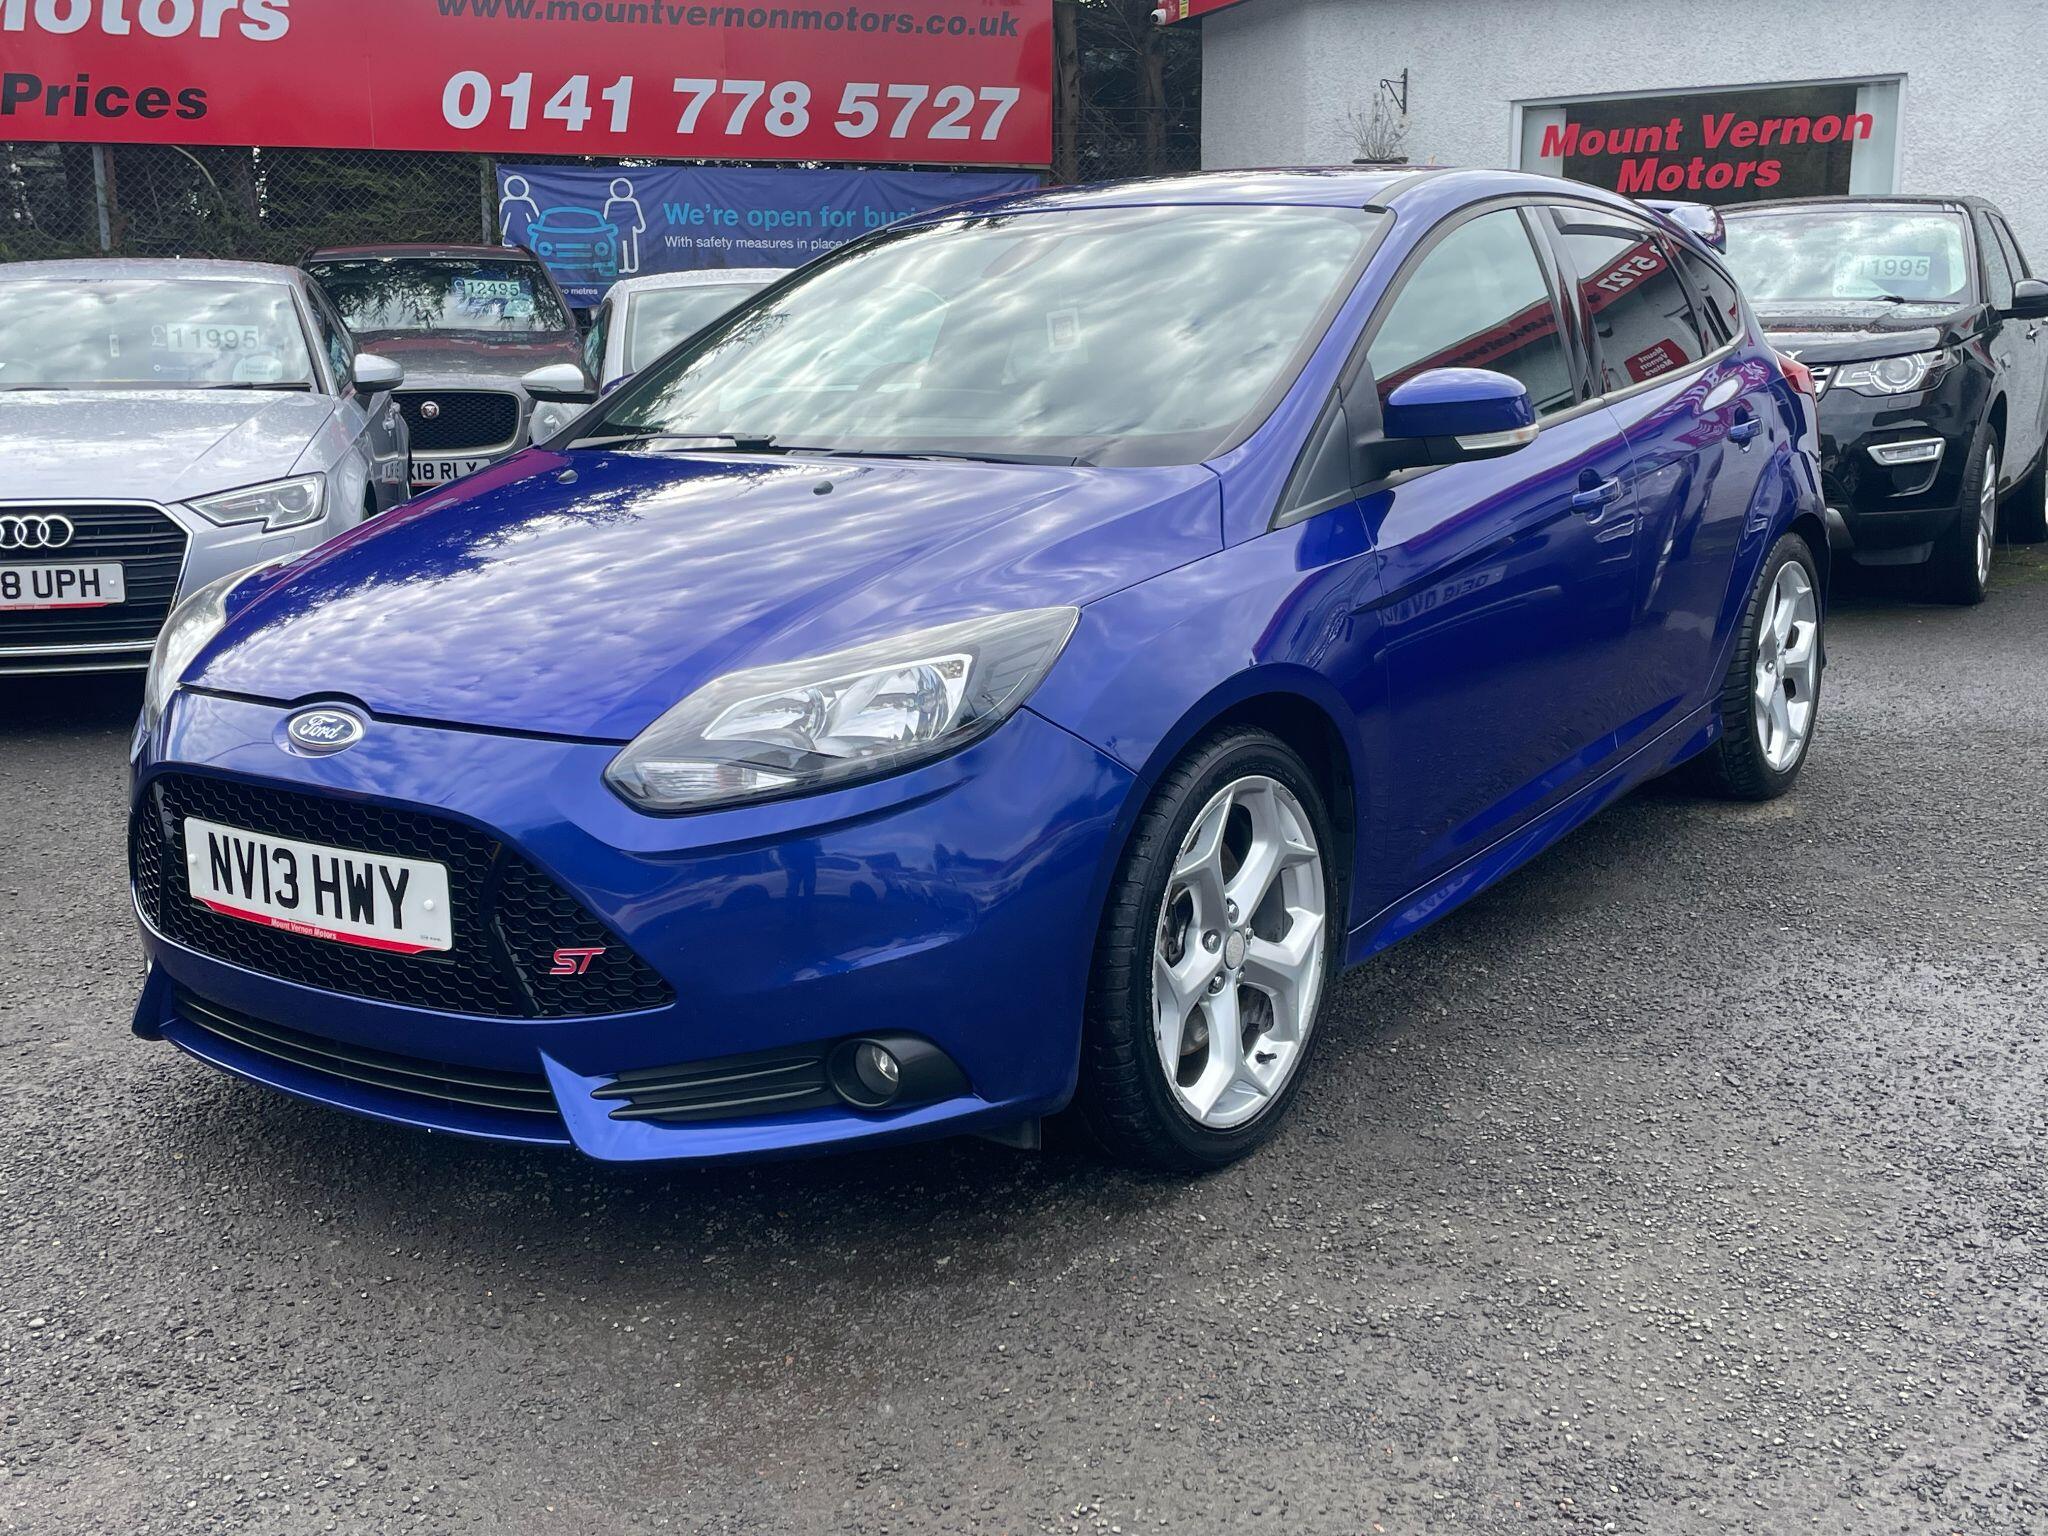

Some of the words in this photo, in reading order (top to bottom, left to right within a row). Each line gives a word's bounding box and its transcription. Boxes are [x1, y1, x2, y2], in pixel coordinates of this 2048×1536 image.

[0, 0, 290, 41] otors
[438, 0, 1019, 37] www.mountvernonmotors.co.uk
[0, 72, 208, 120] Prices
[442, 70, 634, 132] 0141
[673, 78, 811, 138] 778
[834, 83, 1020, 141] 5727
[1540, 118, 1684, 158] Mount
[1700, 111, 1874, 149] Vernon
[1616, 156, 1782, 193] Motors
[663, 203, 738, 227] We’re
[747, 208, 812, 231] open
[820, 205, 856, 228] for
[664, 236, 694, 248] With
[696, 235, 732, 251] safety
[736, 238, 793, 249] measures
[797, 237, 807, 249] in
[811, 237, 842, 251] place
[571, 287, 598, 295] metres
[32, 568, 101, 598] UPH
[299, 715, 345, 740] Ford
[208, 832, 299, 910] NV13
[311, 853, 410, 930] HWY
[271, 918, 290, 930] Mount
[291, 922, 313, 935] Vernon
[314, 927, 337, 940] Motors
[549, 947, 606, 975] ST
